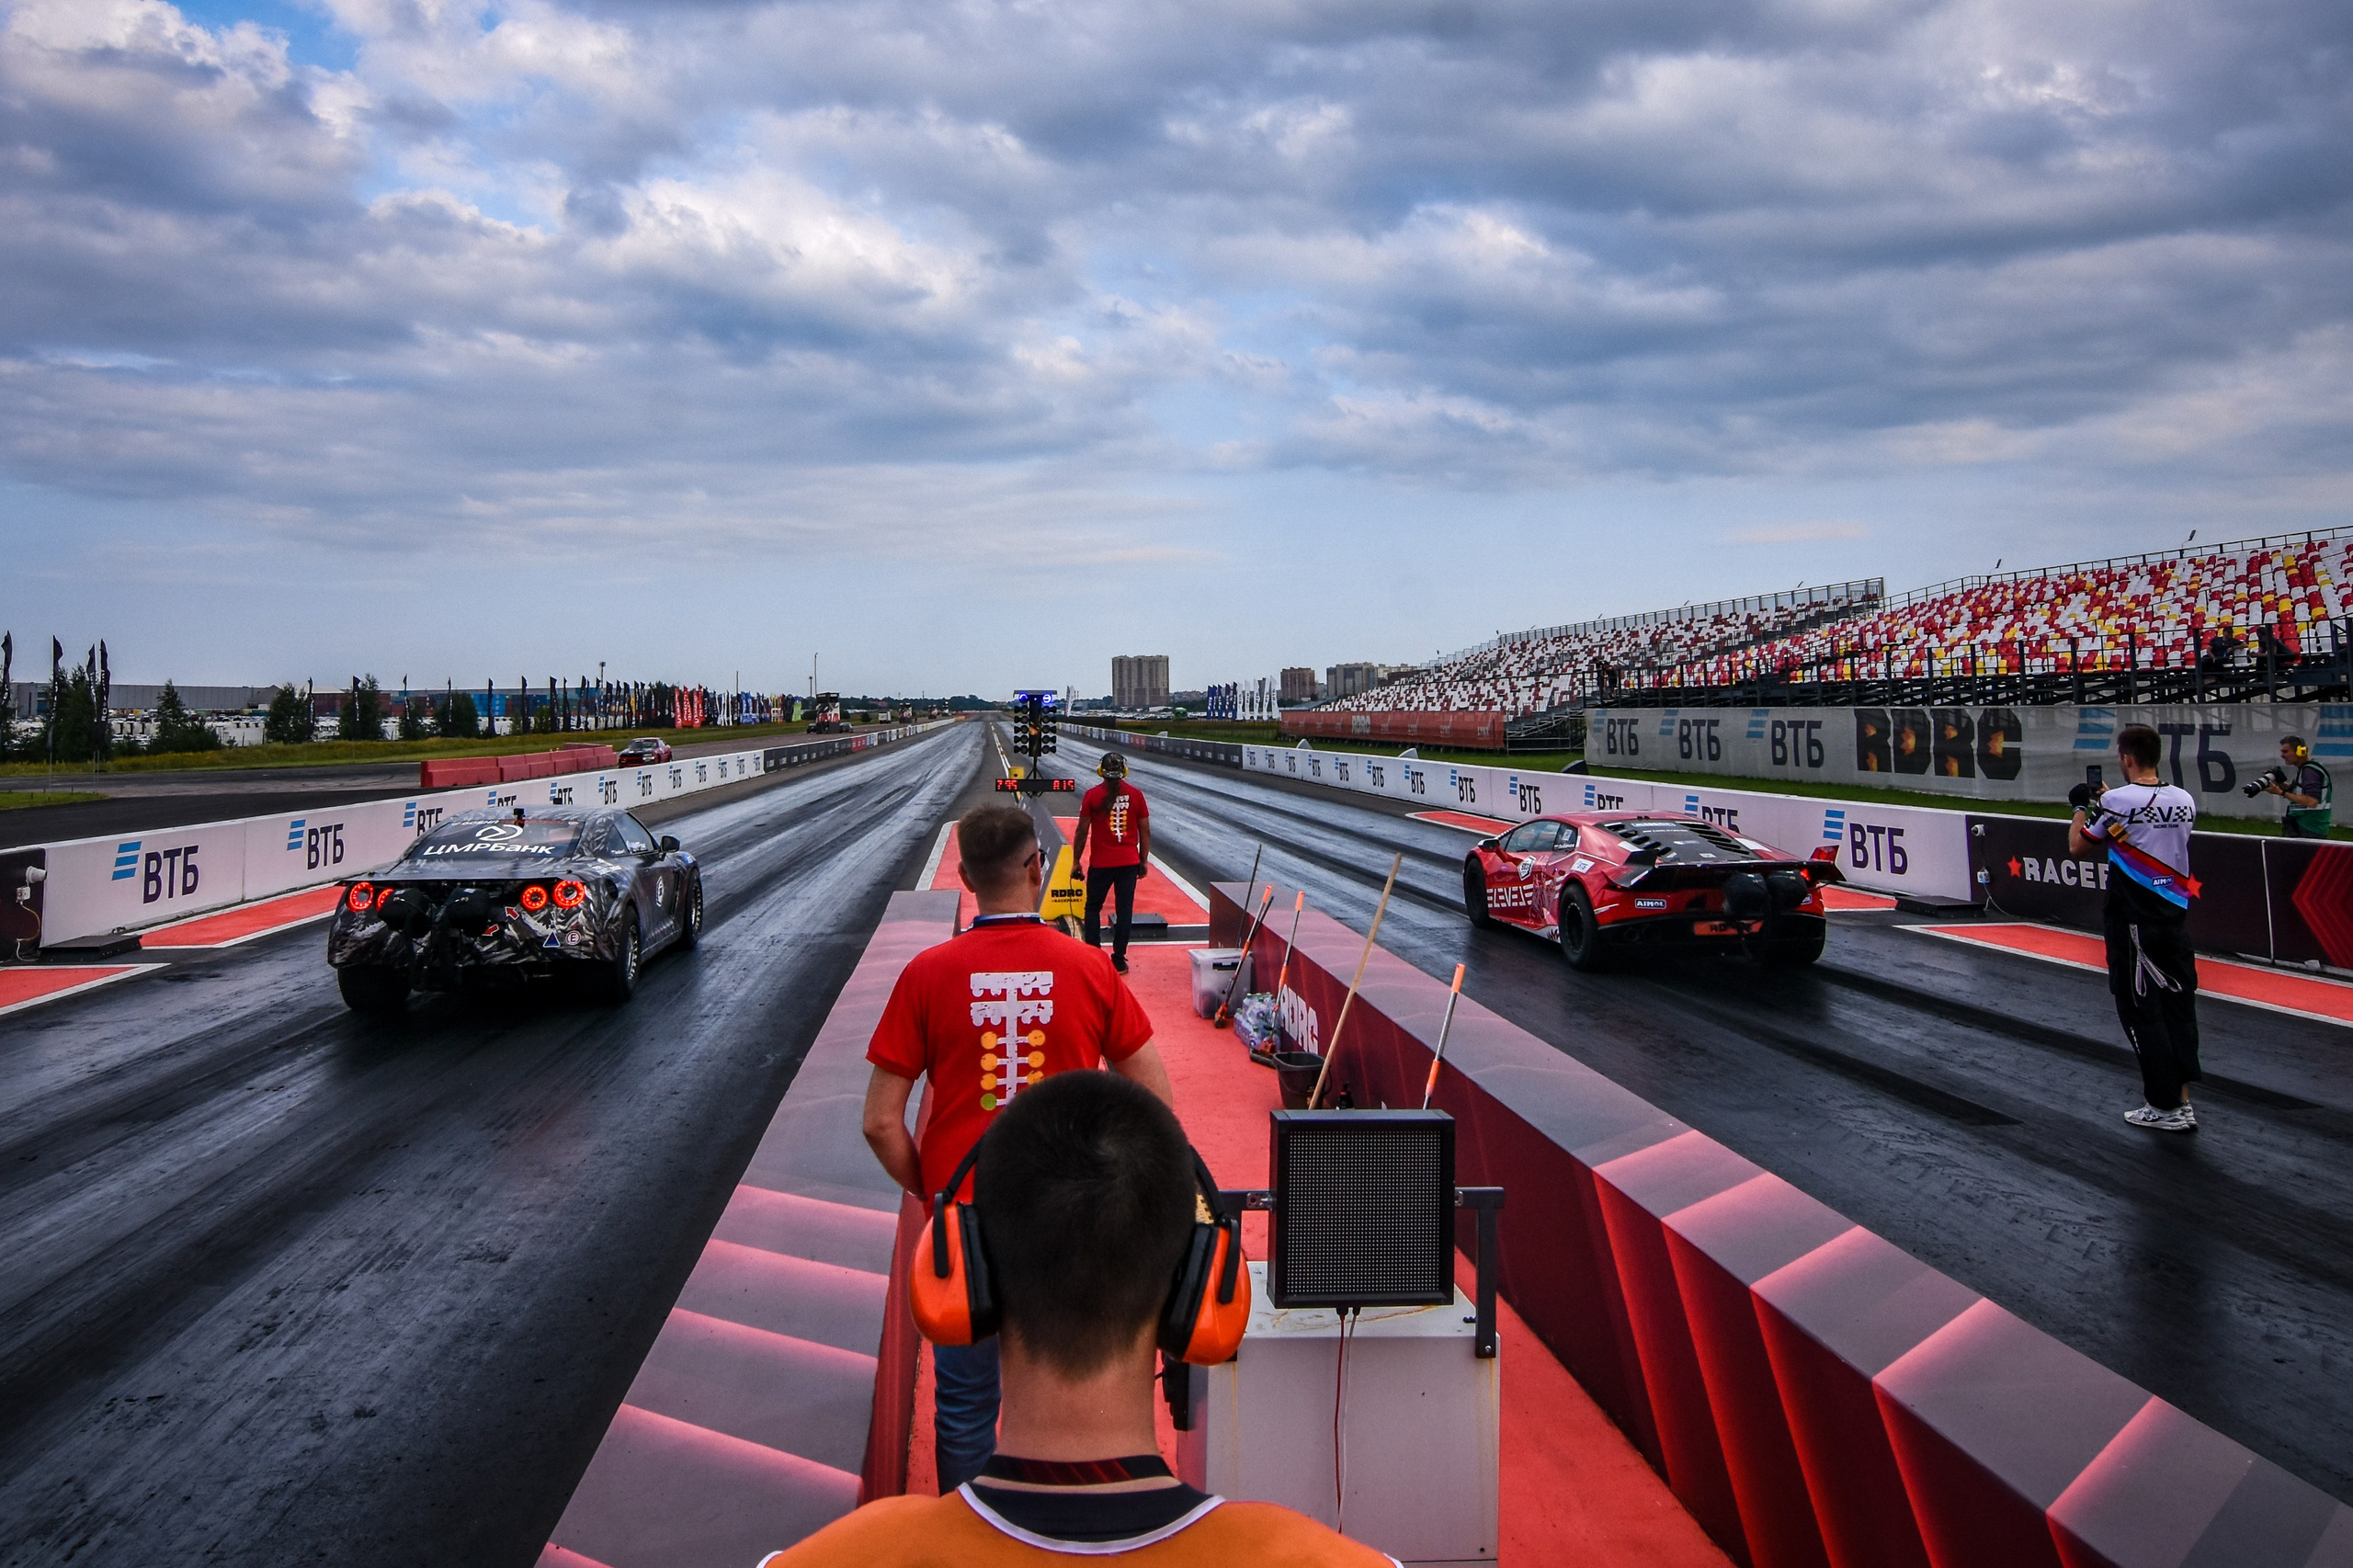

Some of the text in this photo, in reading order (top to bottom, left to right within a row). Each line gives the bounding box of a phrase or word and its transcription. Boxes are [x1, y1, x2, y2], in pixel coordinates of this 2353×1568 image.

[1607, 718, 1639, 756] ВТБ
[1678, 719, 1721, 761] ВТБ
[1771, 720, 1824, 768] ВТБ
[1855, 709, 2022, 781] RDRC
[2125, 723, 2236, 793] ТБ
[604, 780, 618, 805] ВТБ
[642, 775, 652, 797] ВТБ
[1372, 767, 1385, 788] ВТБ
[1411, 771, 1425, 794] ВТБ
[1459, 776, 1476, 802] ВТБ
[1519, 784, 1541, 814] ВТБ
[307, 823, 345, 870] ВТБ
[423, 842, 555, 856] ЦМРБанк
[1849, 823, 1908, 875] ВТБ
[143, 845, 199, 904] ВТБ
[1051, 889, 1083, 898] RDRC
[1636, 900, 1665, 908] AIMOL
